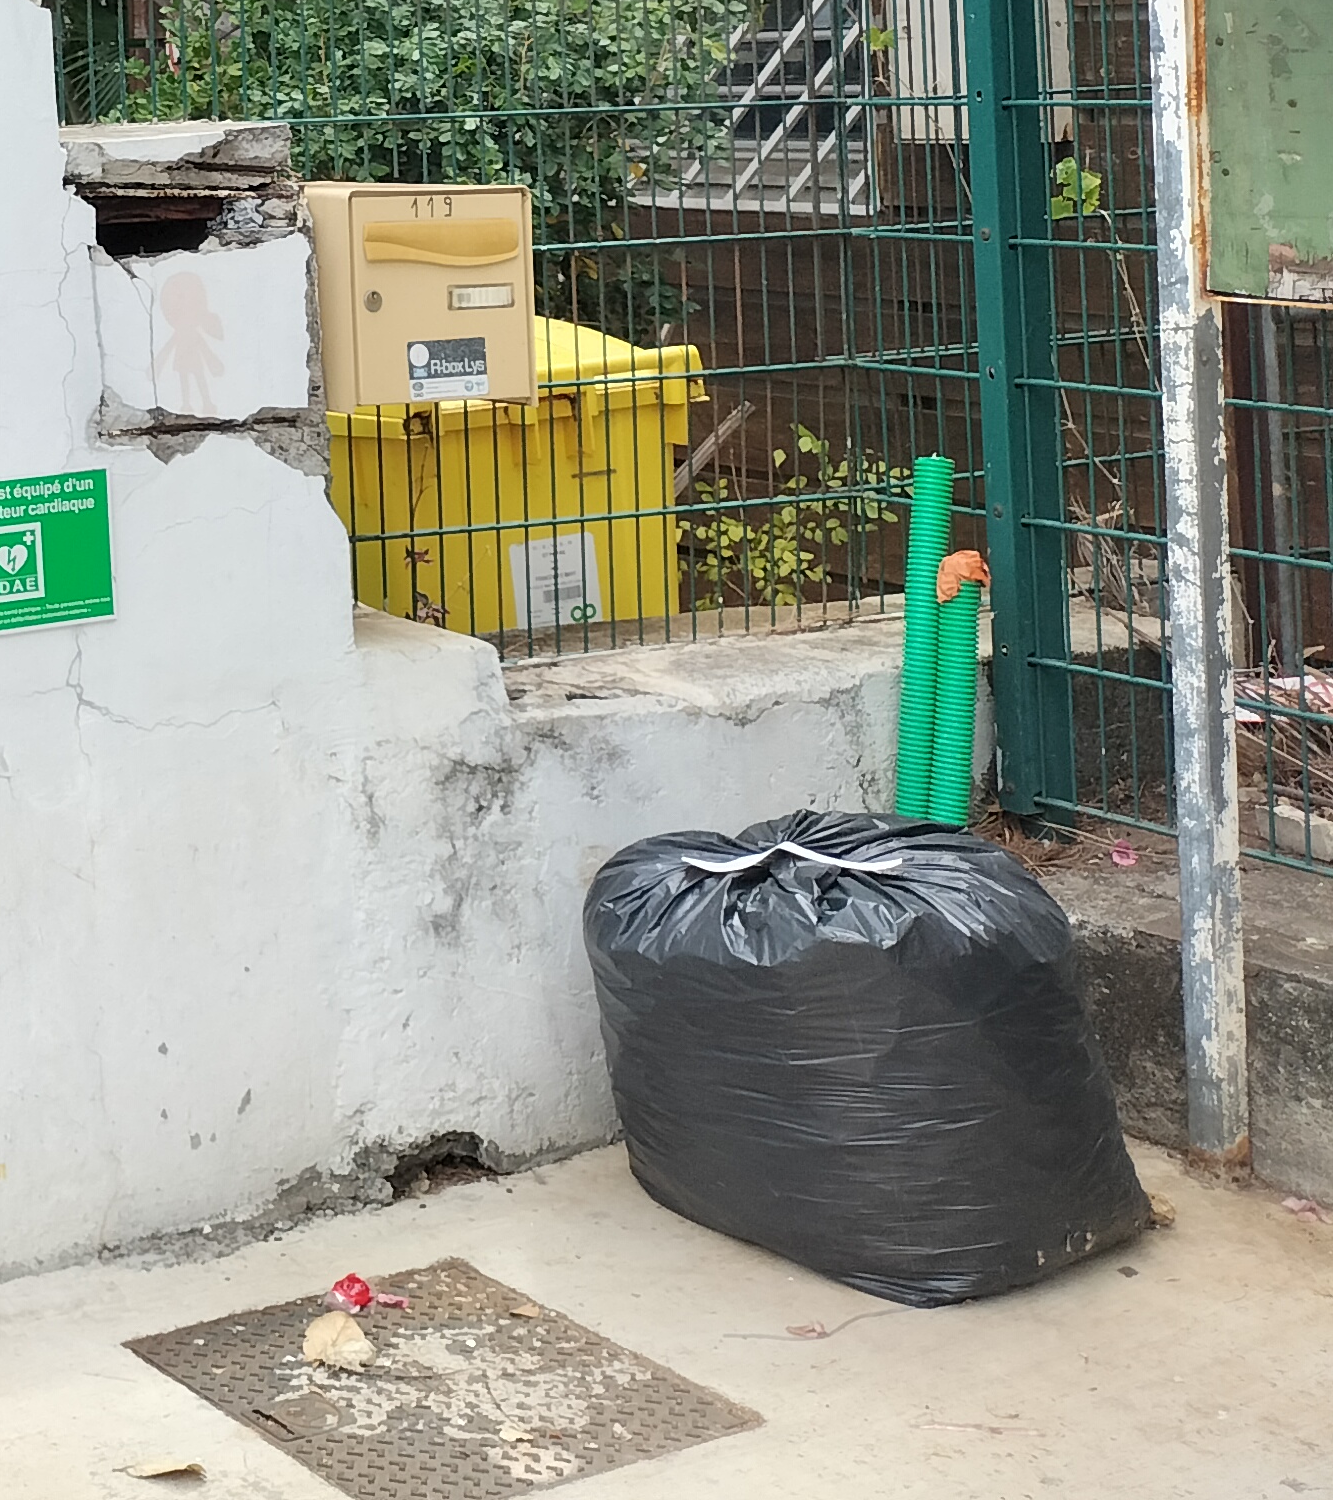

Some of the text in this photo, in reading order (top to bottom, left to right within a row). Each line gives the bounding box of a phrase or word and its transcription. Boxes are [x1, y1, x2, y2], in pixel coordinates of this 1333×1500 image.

[411, 195, 452, 218] 119
[464, 357, 485, 375] Lys
[13, 479, 61, 499] équipé
[64, 478, 94, 492] d'un
[28, 497, 95, 516] cardiaque
